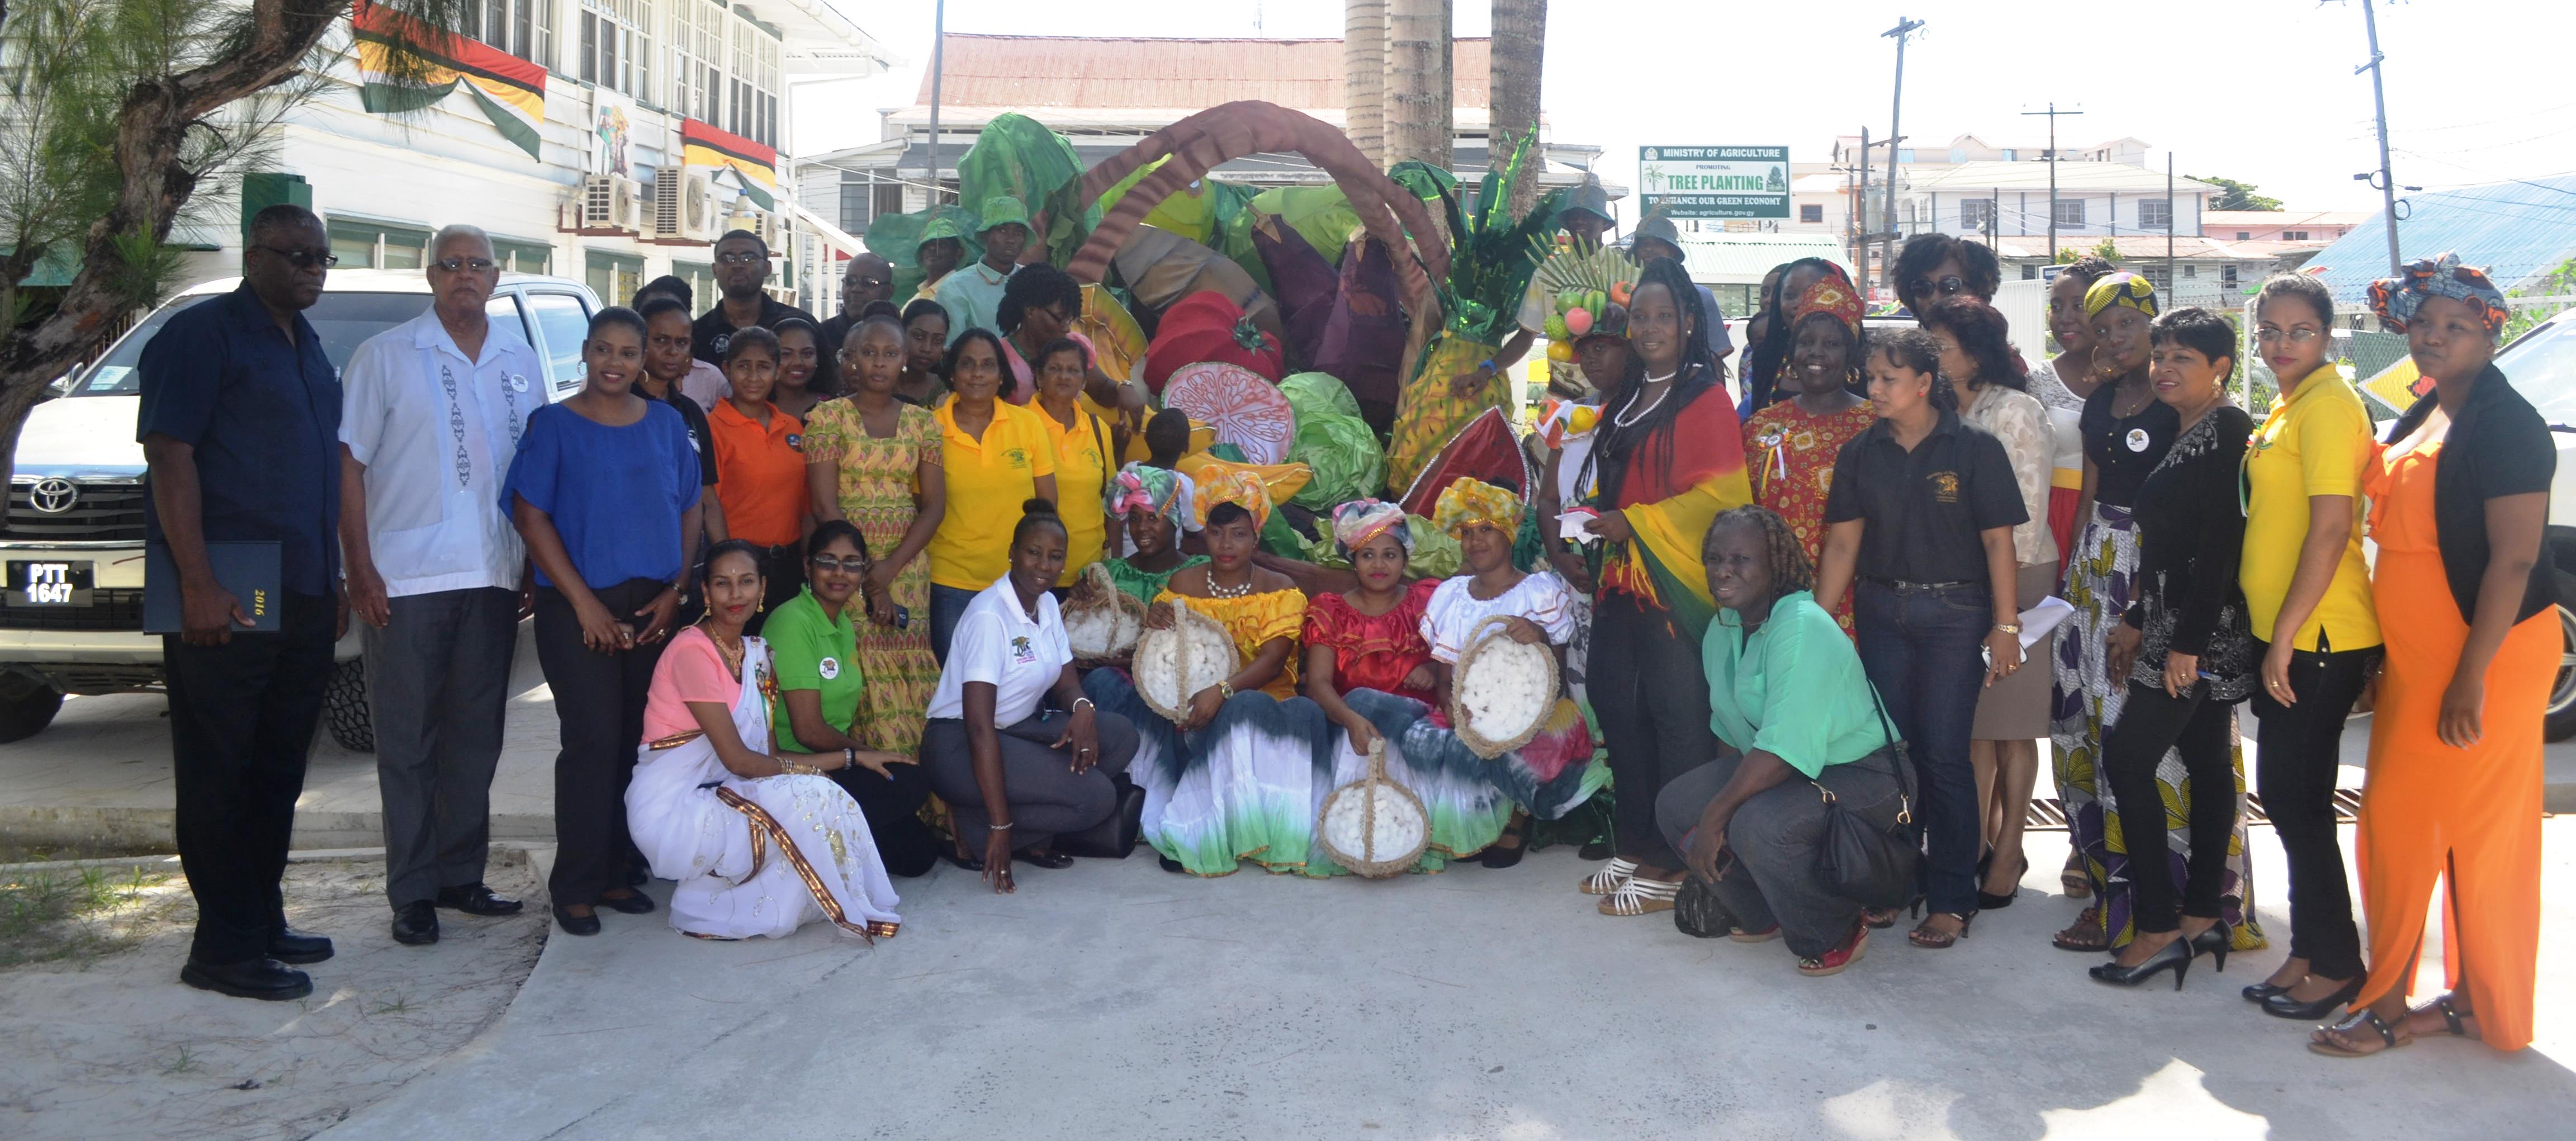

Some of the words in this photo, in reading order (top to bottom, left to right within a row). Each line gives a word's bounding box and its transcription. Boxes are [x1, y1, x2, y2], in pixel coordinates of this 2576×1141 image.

[1663, 149, 1704, 157] MINISTRY
[1707, 149, 1718, 157] OF
[1721, 149, 1781, 157] AGRICULTURE
[1668, 175, 1698, 190] TREE
[1701, 175, 1763, 191] PLANTING
[30, 564, 69, 583] PTT
[27, 583, 73, 603] 1647
[254, 589, 265, 616] 2016
